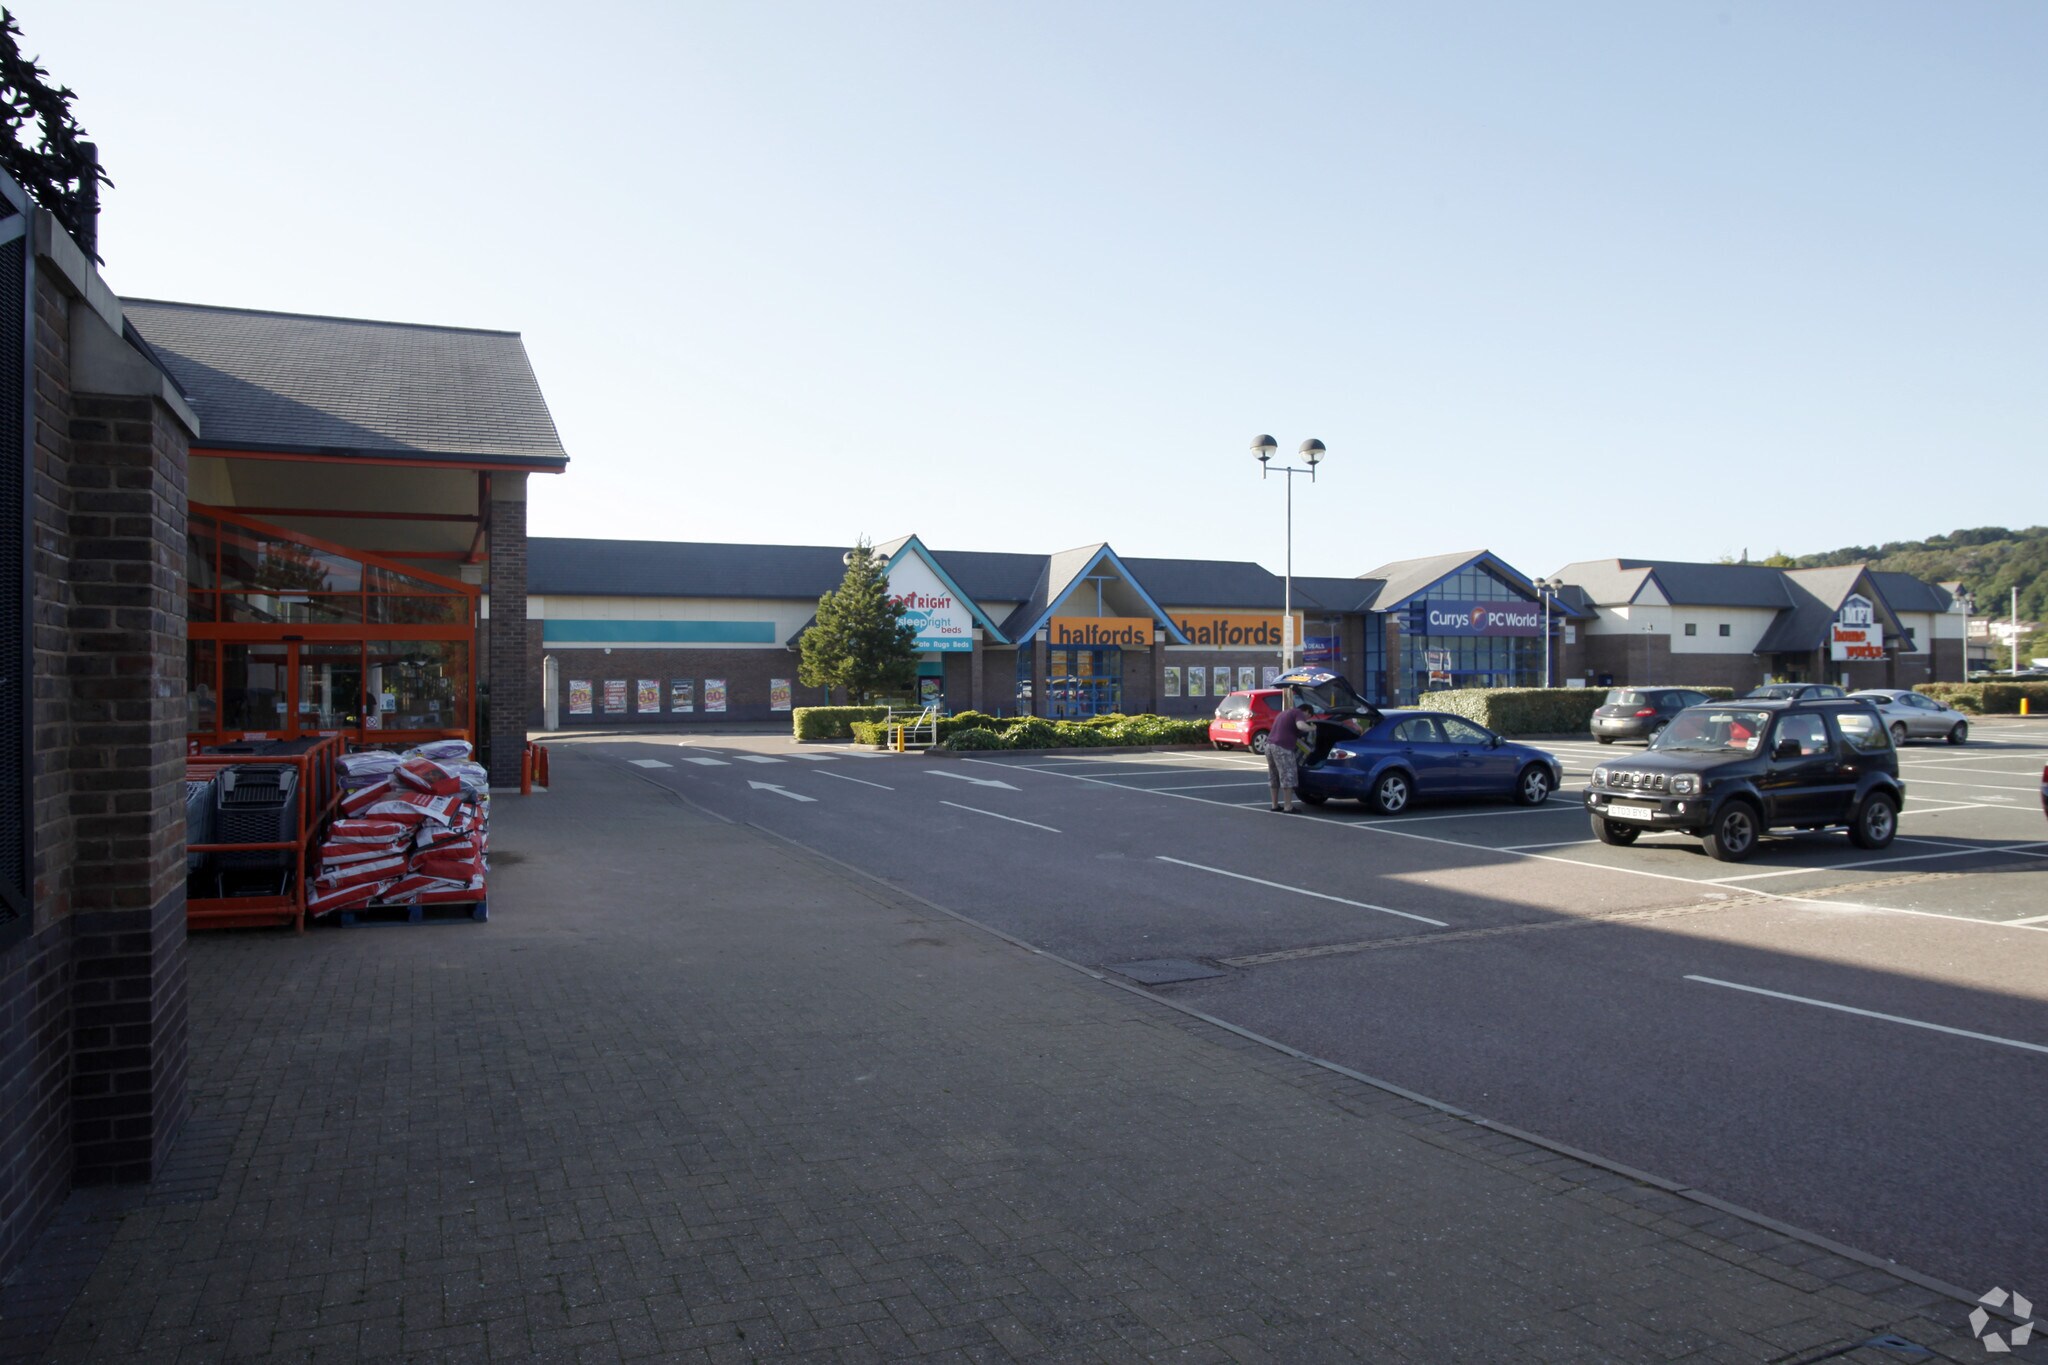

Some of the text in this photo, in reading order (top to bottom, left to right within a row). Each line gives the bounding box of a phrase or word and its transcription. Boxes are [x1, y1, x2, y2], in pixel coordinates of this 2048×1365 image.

[1430, 610, 1537, 628] Currys PC World
[941, 626, 962, 634] beds
[1059, 623, 1145, 645] halfords
[1181, 620, 1282, 645] halfords
[1833, 626, 1866, 642] home
[1845, 642, 1883, 657] works
